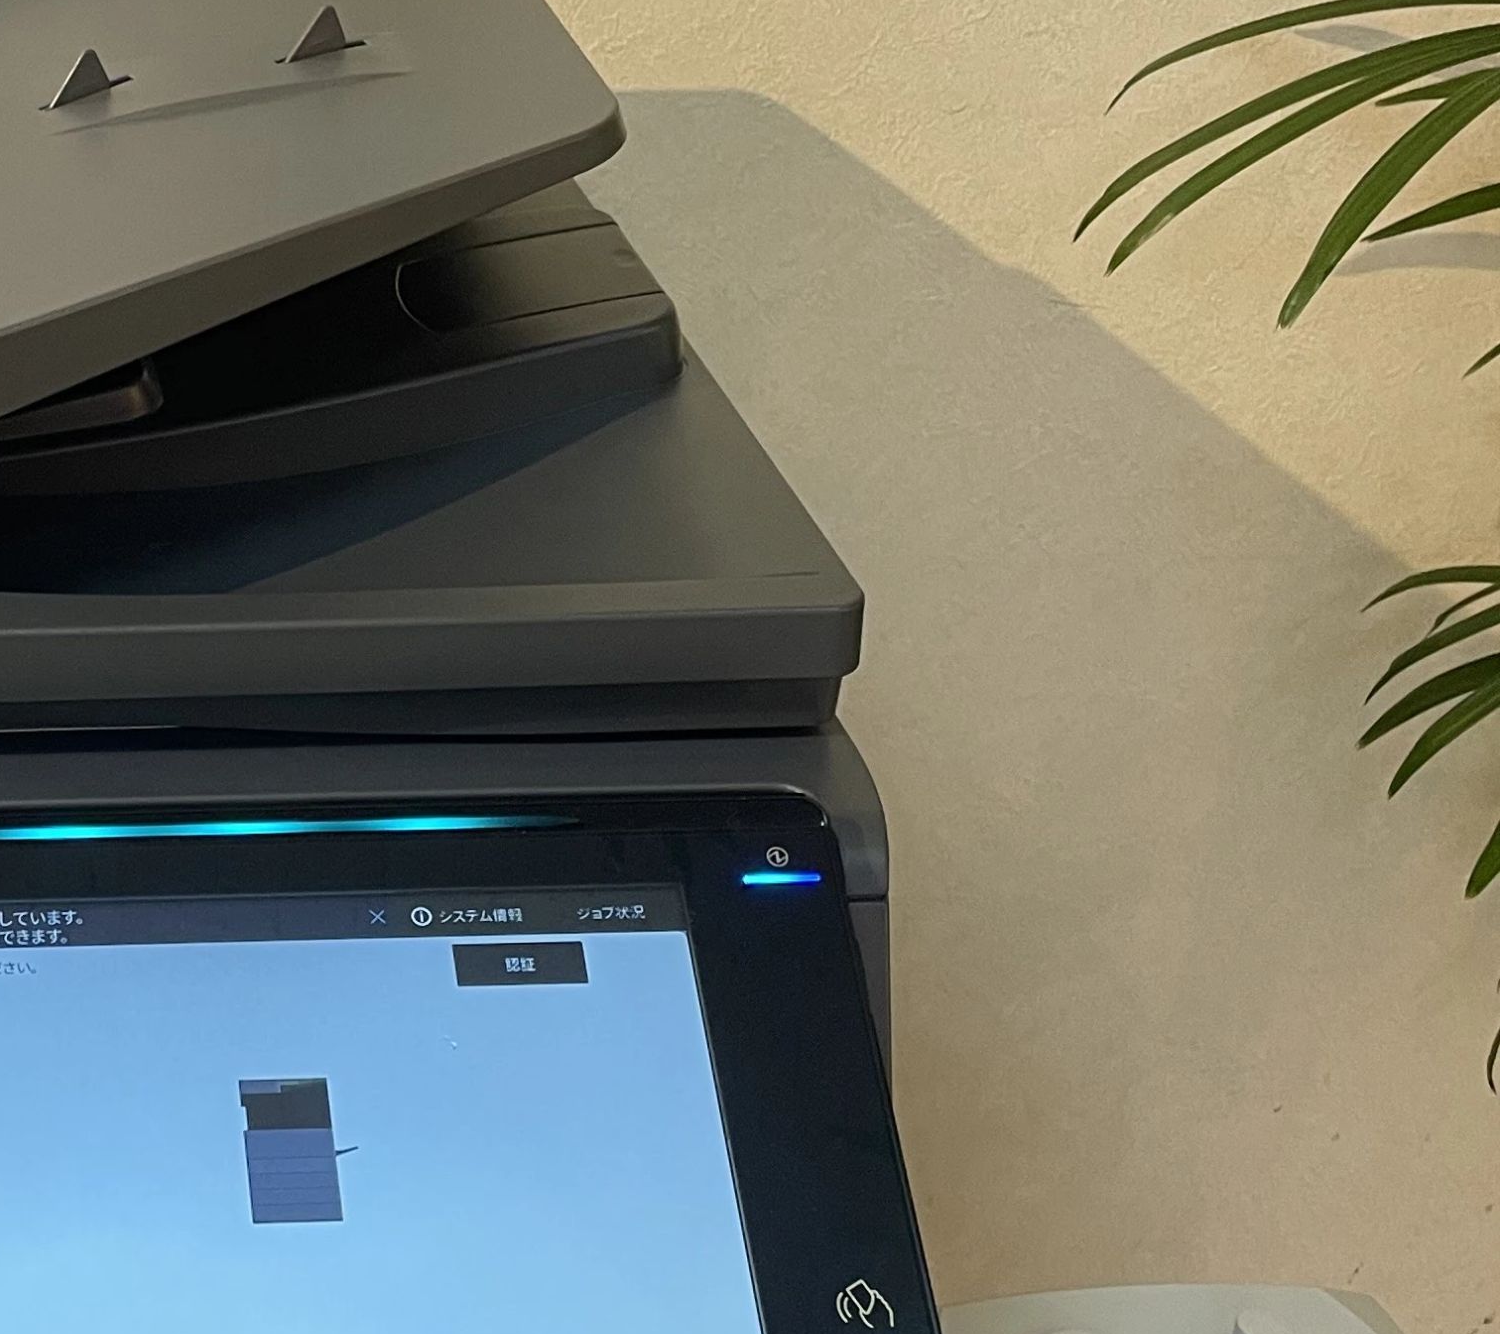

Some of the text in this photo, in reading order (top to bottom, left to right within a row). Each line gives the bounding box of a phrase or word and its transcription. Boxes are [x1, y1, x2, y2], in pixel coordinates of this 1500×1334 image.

[439, 907, 523, 924] システム情報
[577, 904, 646, 920] ジョブ状況
